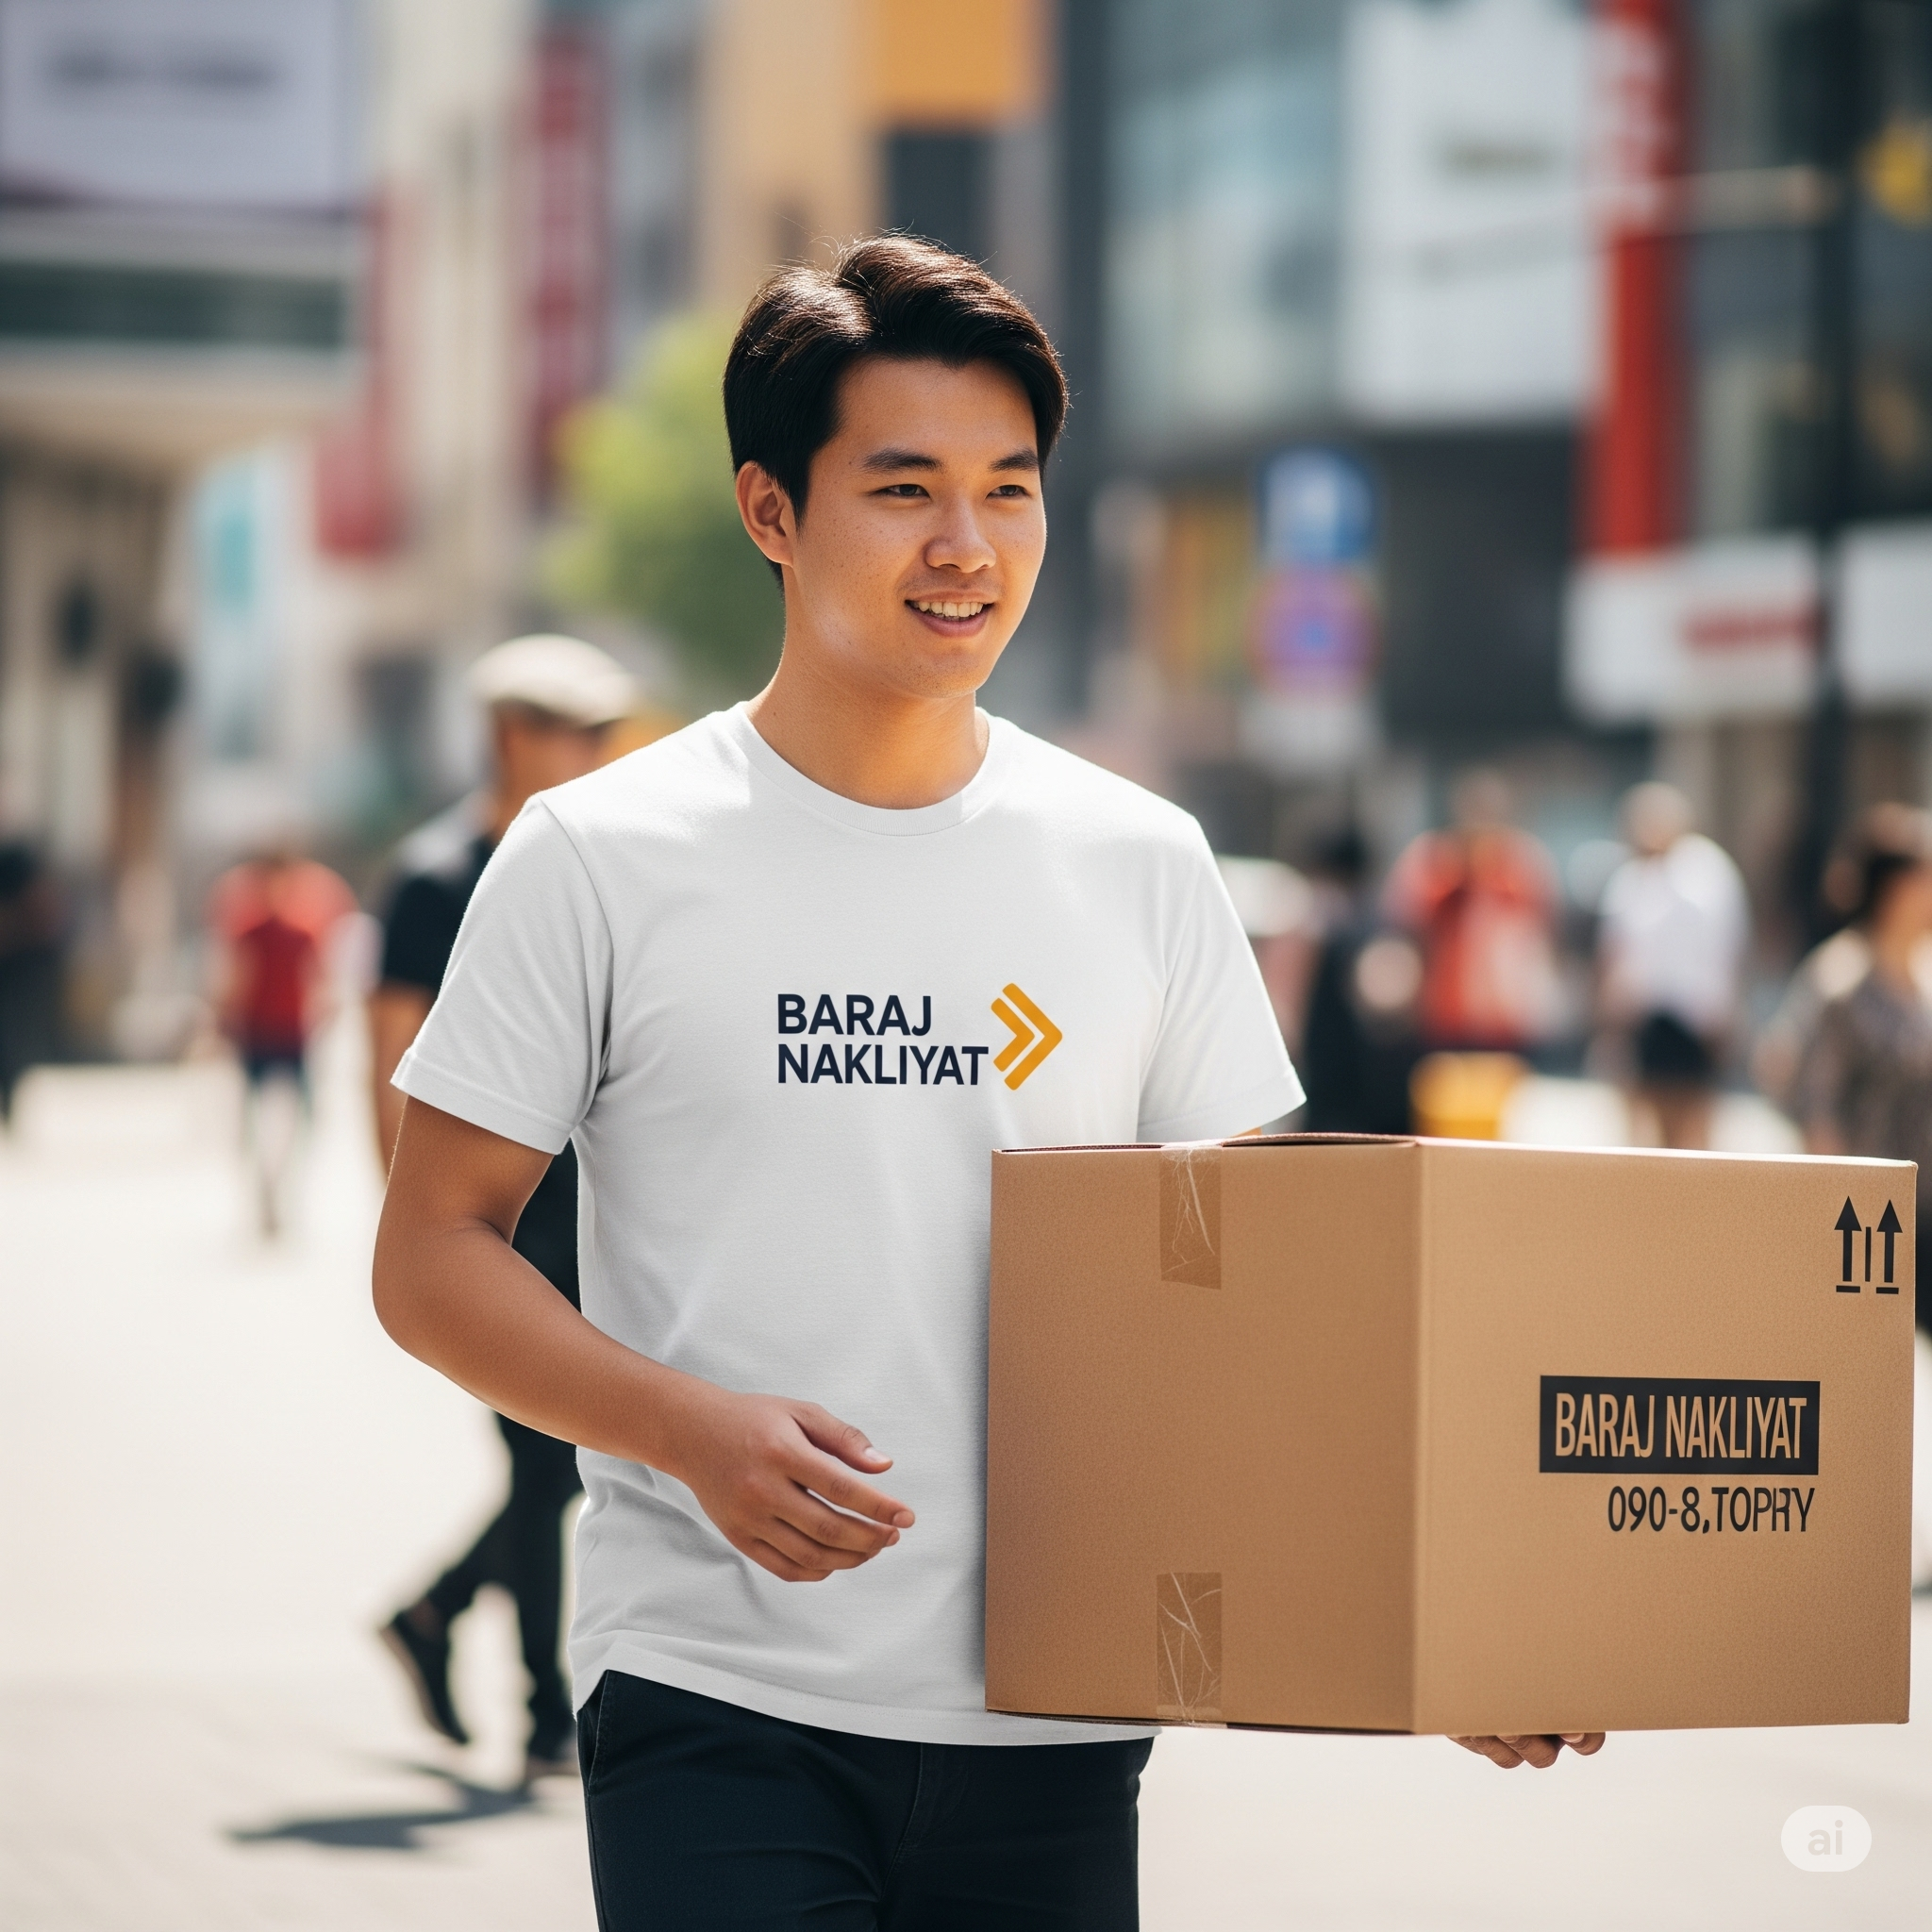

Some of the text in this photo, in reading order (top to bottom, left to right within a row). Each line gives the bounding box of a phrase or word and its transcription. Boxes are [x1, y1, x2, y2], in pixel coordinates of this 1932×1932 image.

[777, 993, 932, 1037] BARAJ
[777, 1043, 990, 1086] NAKLIYAT
[1556, 1392, 1807, 1458] BARAJ NAKLIYAT
